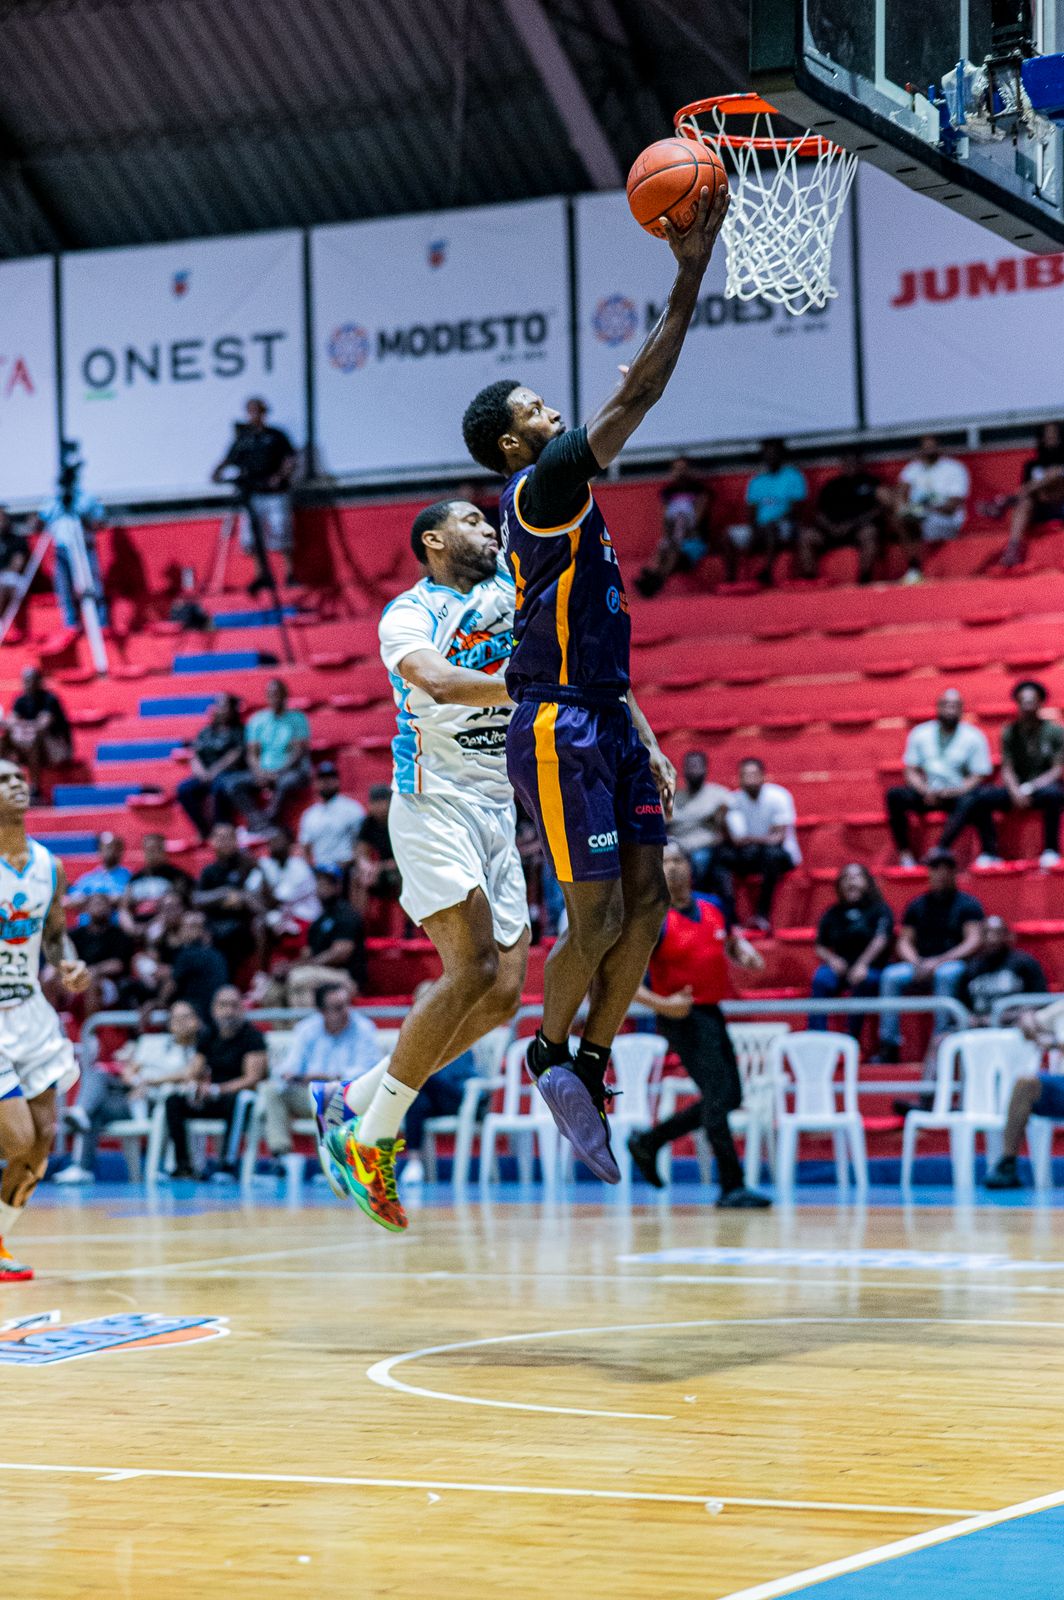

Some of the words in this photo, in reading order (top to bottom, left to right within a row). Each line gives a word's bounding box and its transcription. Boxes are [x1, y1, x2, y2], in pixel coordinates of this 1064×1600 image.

[891, 254, 1064, 308] JUMB
[82, 331, 287, 390] ONEST
[376, 311, 547, 361] MODESTO
